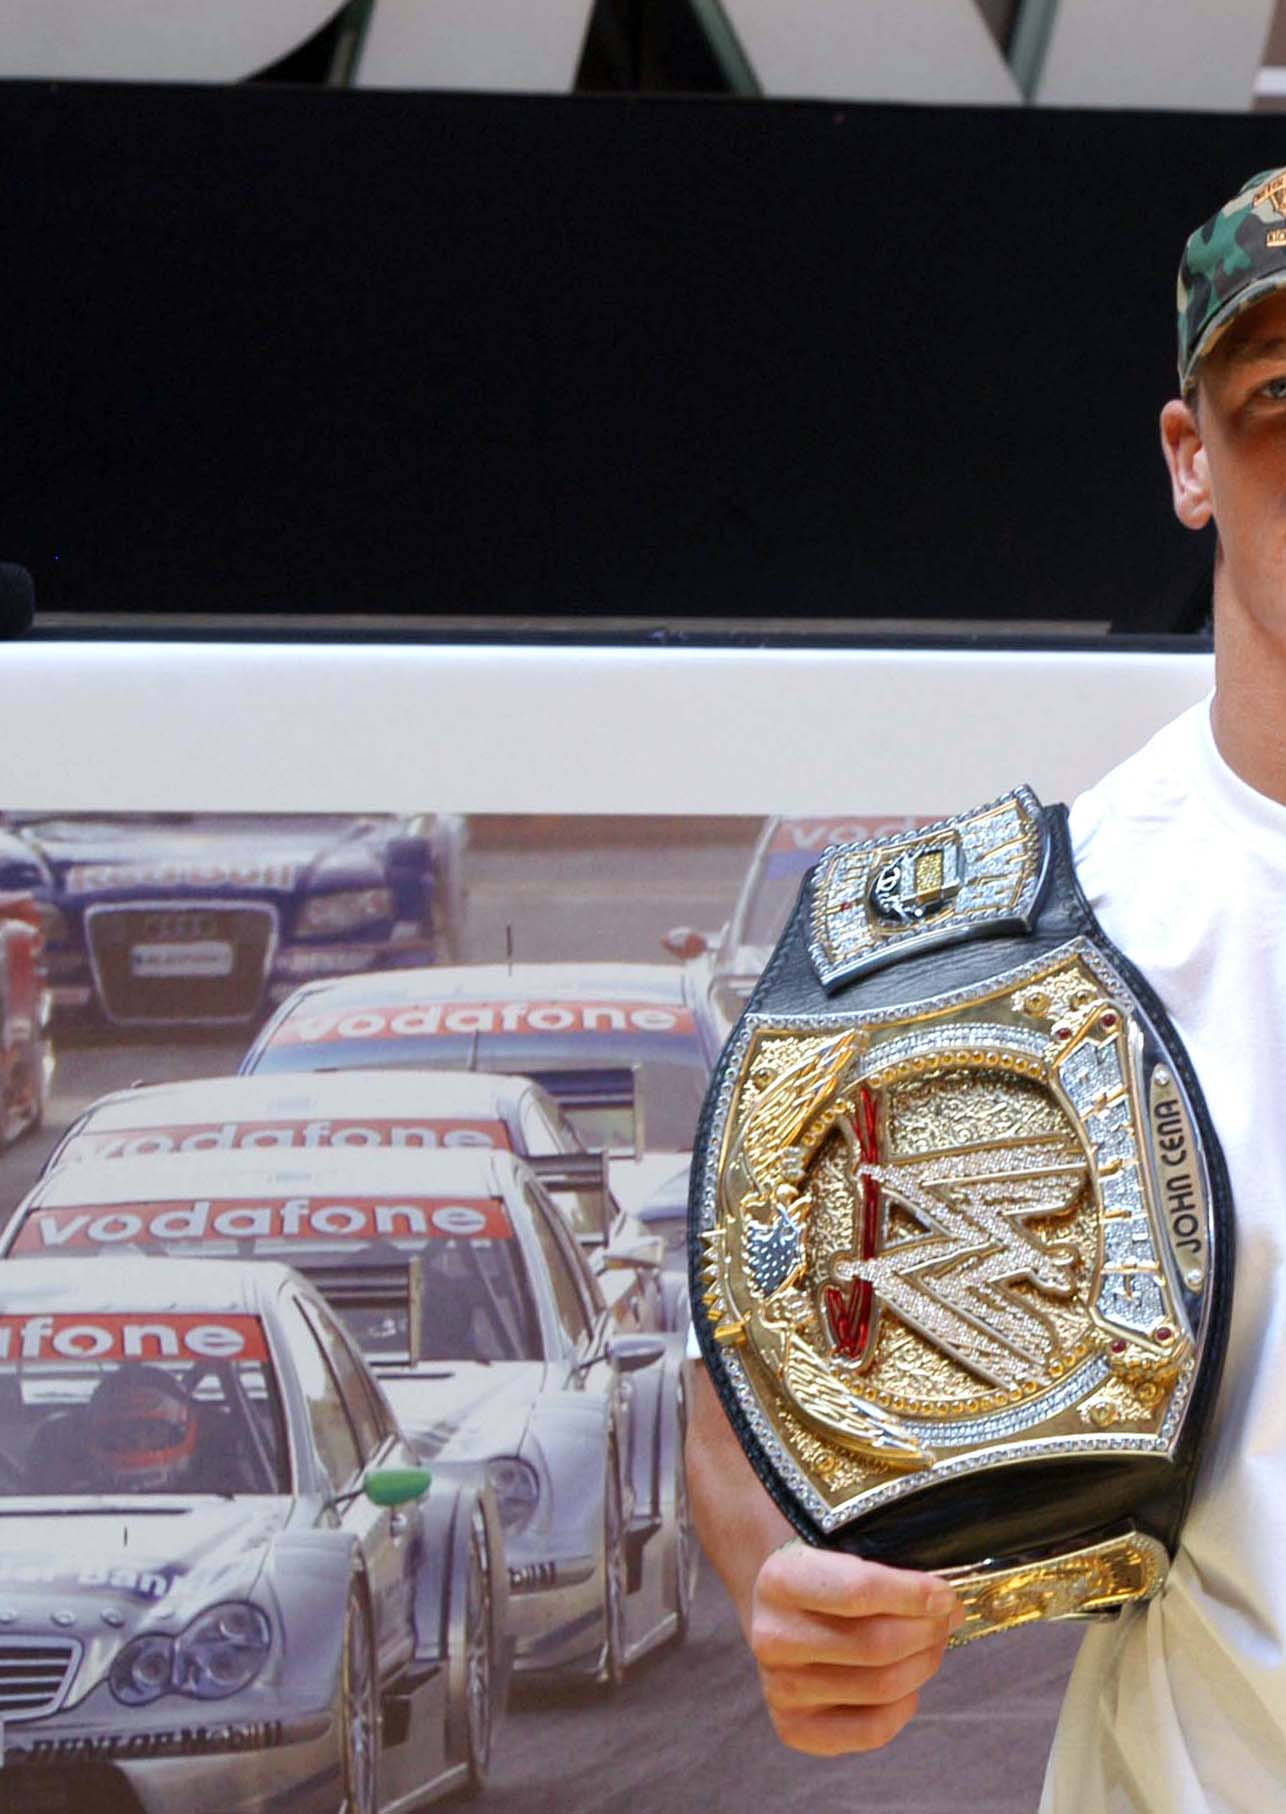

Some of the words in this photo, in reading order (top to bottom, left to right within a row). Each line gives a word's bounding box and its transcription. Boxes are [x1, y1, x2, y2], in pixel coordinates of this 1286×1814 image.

[299, 1005, 677, 1041] vodafone
[1154, 1098, 1187, 1166] CENA
[38, 1199, 486, 1246] vodafone
[1166, 1174, 1200, 1252] JOHN
[0, 1316, 245, 1359] fone
